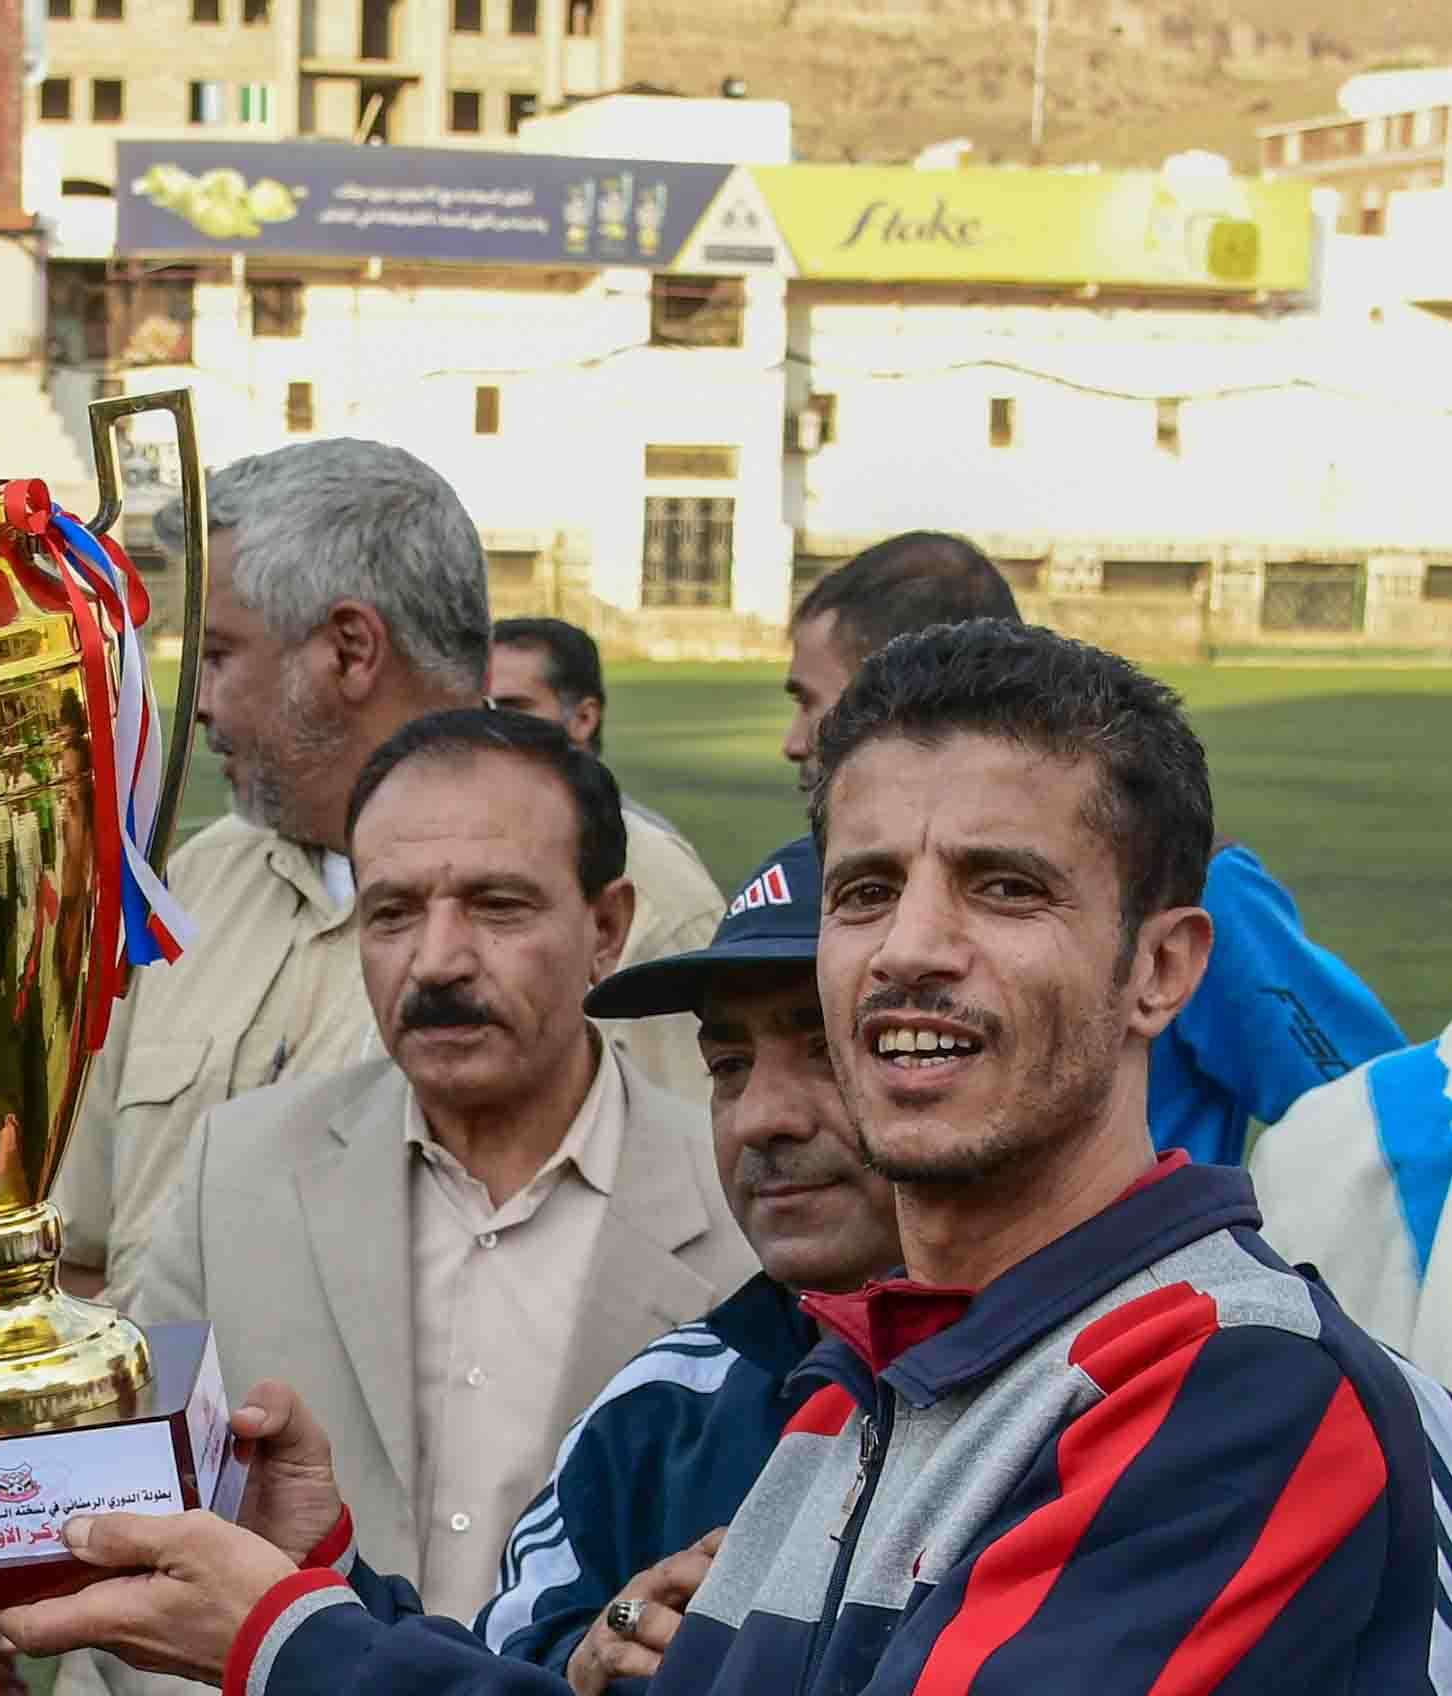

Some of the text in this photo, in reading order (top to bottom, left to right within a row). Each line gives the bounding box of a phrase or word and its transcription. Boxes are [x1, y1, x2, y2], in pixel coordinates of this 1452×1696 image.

[109, 1491, 140, 1509] الدوري
[142, 1488, 172, 1502] بطولة
[16, 1505, 46, 1517] نسخته
[48, 1503, 60, 1518] في
[63, 1496, 105, 1514] الرمضاني
